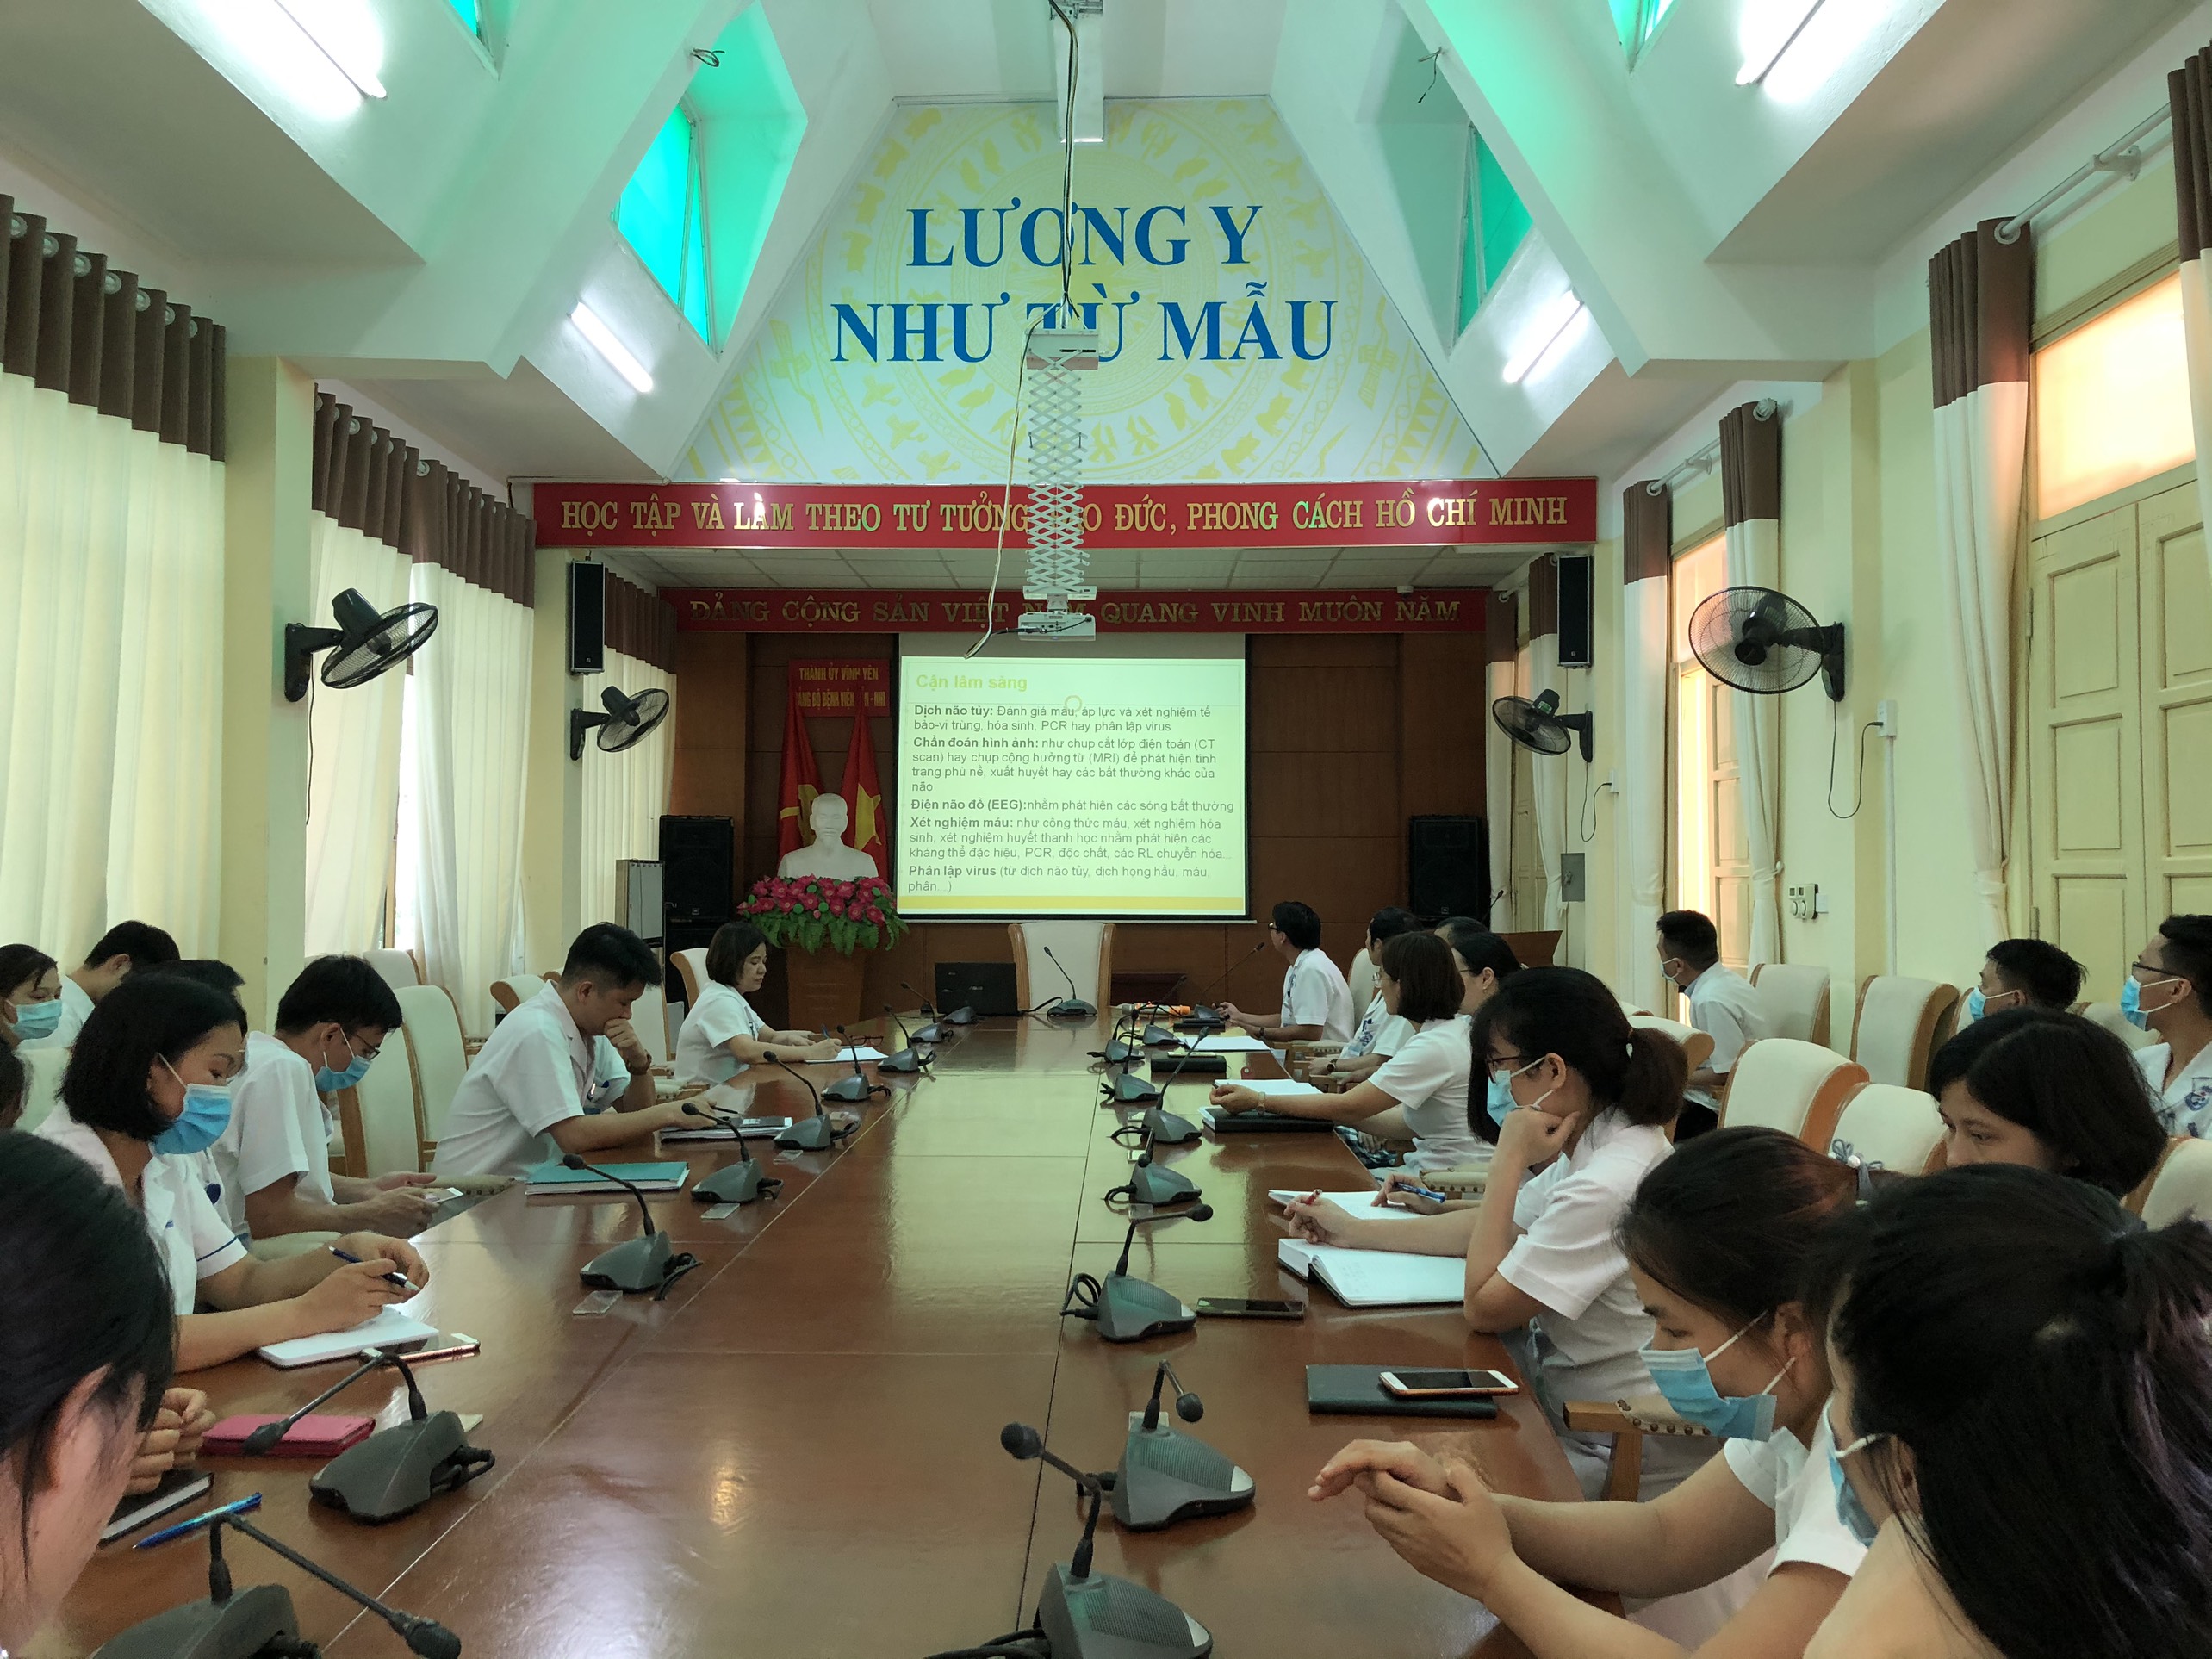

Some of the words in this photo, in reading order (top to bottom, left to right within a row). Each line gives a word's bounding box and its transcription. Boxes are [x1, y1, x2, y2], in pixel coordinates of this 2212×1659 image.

[906, 196, 1190, 267] LƯƠNG
[1209, 205, 1263, 264] Y
[830, 292, 1010, 362] NHƯ
[1157, 281, 1338, 362] MẪU
[561, 501, 618, 537] HỌC
[630, 494, 681, 537] TẬP
[691, 493, 725, 529] VÀ
[734, 492, 794, 531] LÀM
[805, 504, 881, 531] THEO
[893, 500, 931, 531] TƯ
[940, 491, 1028, 532] TƯỞNG
[1115, 494, 1177, 535] ĐỨC,
[1187, 501, 1278, 531] PHONG
[1293, 492, 1363, 529] CÁCH
[1375, 487, 1416, 527] HỒ
[1427, 489, 1478, 527] CHÍ
[1488, 497, 1568, 525] MINH
[690, 592, 770, 622] ĐẢNG
[782, 595, 861, 628] CỘNG
[873, 594, 929, 623] SẢN
[941, 596, 1009, 629] VIỆT
[1101, 602, 1198, 625] QUANG
[1211, 602, 1284, 623] VINH
[1299, 595, 1383, 623] MUÔN
[1395, 595, 1460, 622] NĂM
[916, 675, 948, 691] Cận
[954, 675, 982, 688] lâm
[915, 705, 941, 718] Dịch
[946, 706, 967, 715] não
[997, 706, 1027, 716] Đánh
[1030, 706, 1047, 718] giá
[1082, 708, 1095, 718] áp
[1099, 708, 1115, 718] lực
[1120, 708, 1132, 717] và
[1136, 708, 1152, 717] xét
[1156, 708, 1196, 718] nghiệm
[1200, 705, 1211, 717] tế
[988, 720, 1008, 730] hóa
[1012, 721, 1036, 731] sinh,
[1041, 721, 1067, 730] PCR
[1072, 722, 1090, 732] hay
[1095, 722, 1122, 732] phân
[1126, 722, 1141, 733] lập
[1146, 722, 1171, 731] virus
[914, 736, 945, 748] Chẩn
[948, 737, 979, 748] đoán
[983, 737, 1008, 748] hình
[1042, 739, 1065, 749] như
[1068, 739, 1095, 750] chụp
[1118, 739, 1135, 750] lớp
[1140, 739, 1162, 750] điện
[1166, 739, 1190, 749] toán
[1194, 739, 1215, 749] (CT
[913, 752, 943, 762] scan)
[948, 752, 966, 763] hay
[972, 752, 998, 764] chụp
[1002, 753, 1029, 764] cộng
[1089, 753, 1119, 764] (MRI)
[1141, 753, 1165, 765] phát
[1169, 754, 1191, 765] hiện
[1196, 754, 1216, 763] tình
[912, 767, 941, 778] trạng
[945, 767, 965, 778] phù
[991, 765, 1014, 777] xuất
[1018, 766, 1048, 779] huyết
[1053, 767, 1072, 779] hay
[1076, 768, 1095, 777] các
[1099, 766, 1115, 778] bất
[1165, 768, 1190, 778] khác
[1195, 768, 1215, 778] của
[912, 782, 933, 791] não
[911, 799, 939, 811] Điện
[942, 800, 965, 809] não
[968, 798, 984, 810] đồ
[1062, 800, 1086, 811] phát
[1090, 801, 1113, 811] hiện
[1117, 801, 1136, 811] các
[1140, 801, 1167, 812] sóng
[1171, 799, 1189, 811] bất
[910, 817, 931, 827] Xét
[935, 817, 979, 830] nghiệm
[984, 818, 1013, 828] máu:
[1017, 818, 1040, 828] như
[1043, 818, 1070, 830] công
[1074, 818, 1099, 828] thức
[1103, 819, 1129, 830] máu,
[1134, 819, 1150, 829] xét
[1155, 819, 1195, 830] nghiệm
[1200, 819, 1221, 829] hóa
[910, 833, 935, 843] sinh,
[941, 833, 957, 842] xét
[961, 833, 1003, 844] nghiệm
[1007, 830, 1038, 844] huyết
[1041, 833, 1072, 842] thanh
[1077, 834, 1097, 844] học
[1136, 834, 1160, 845] phát
[1165, 834, 1187, 845] hiện
[1192, 835, 1211, 843] các
[910, 848, 944, 859] kháng
[969, 848, 990, 860] đặc
[994, 848, 1020, 859] hiệu,
[1025, 848, 1054, 859] PCR,
[1059, 848, 1079, 859] độc
[1084, 846, 1109, 859] chất,
[1115, 848, 1134, 858] các
[1138, 848, 1154, 858] RL
[909, 866, 940, 876] Phân
[944, 866, 961, 878] lập
[966, 866, 996, 876] virus
[1020, 866, 1043, 878] dịch
[1047, 867, 1068, 876] não
[1096, 867, 1118, 878] dịch
[1123, 867, 1151, 879] họng
[1183, 867, 1210, 878] máu,
